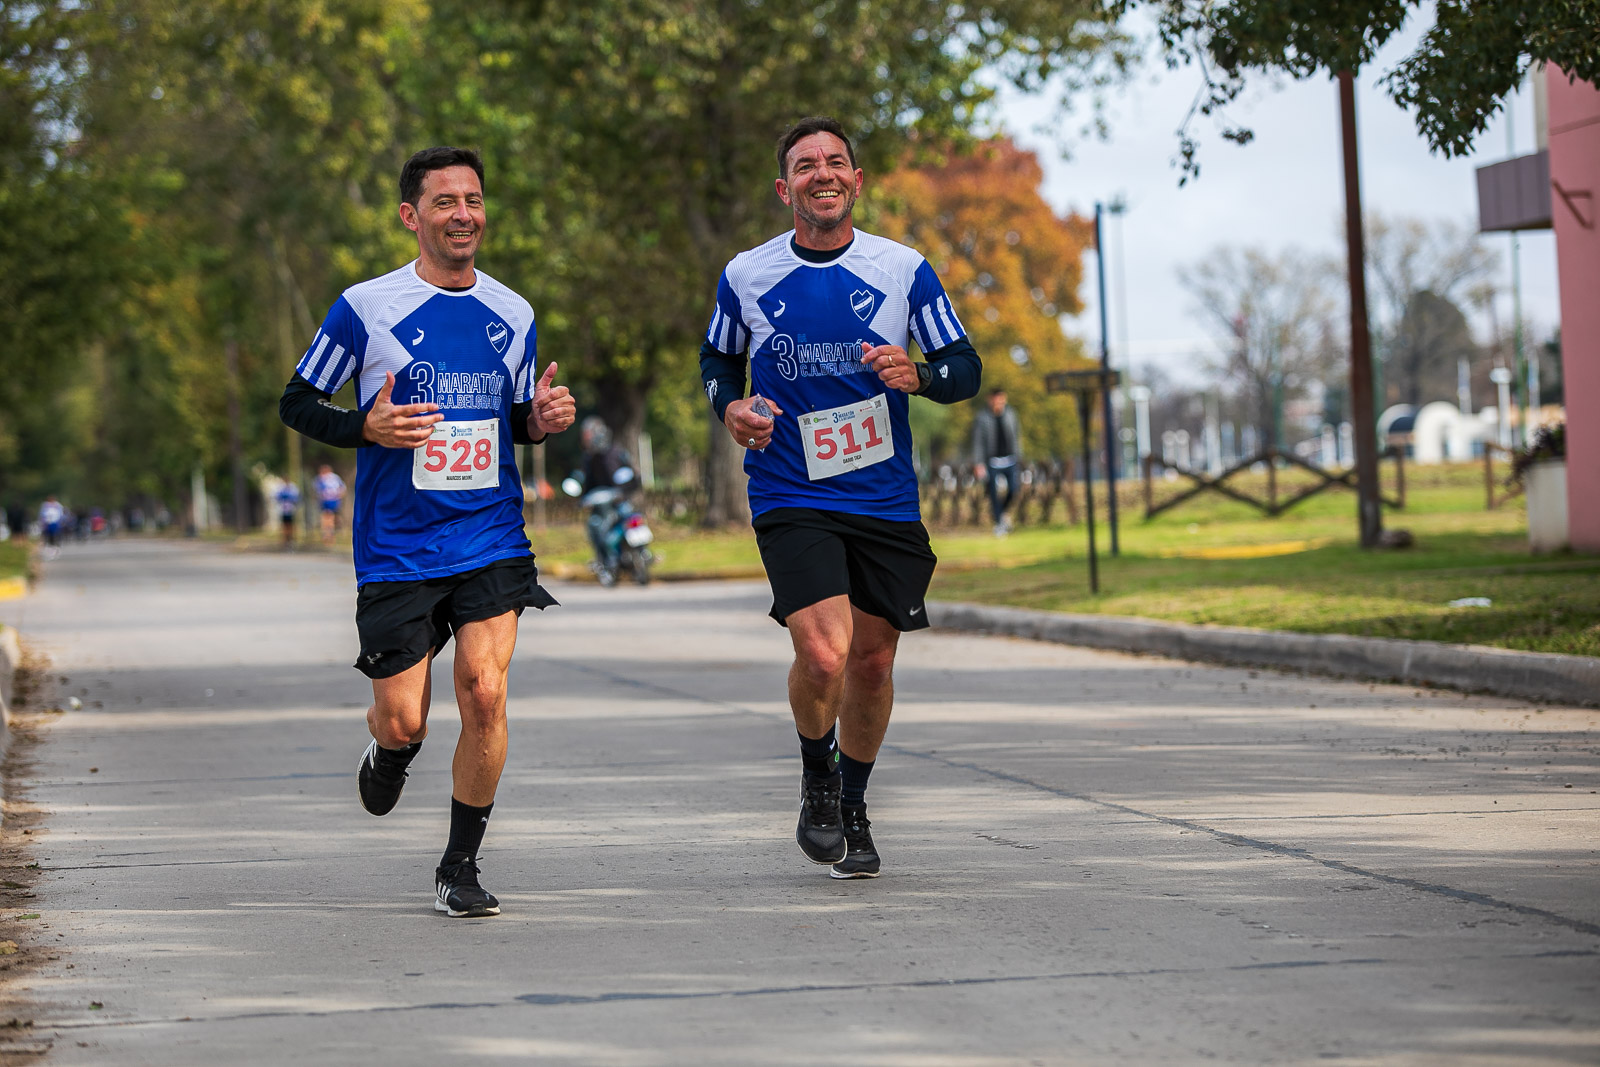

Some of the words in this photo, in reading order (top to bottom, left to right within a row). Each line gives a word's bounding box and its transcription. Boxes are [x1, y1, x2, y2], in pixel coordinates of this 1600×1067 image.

[772, 334, 798, 381] 3
[797, 339, 874, 364] MARATÓ
[409, 361, 435, 414] 3
[437, 370, 505, 396] MARATÓN
[450, 425, 457, 437] 3
[832, 412, 839, 423] 3
[814, 415, 883, 460] 511
[423, 438, 492, 472] 528
